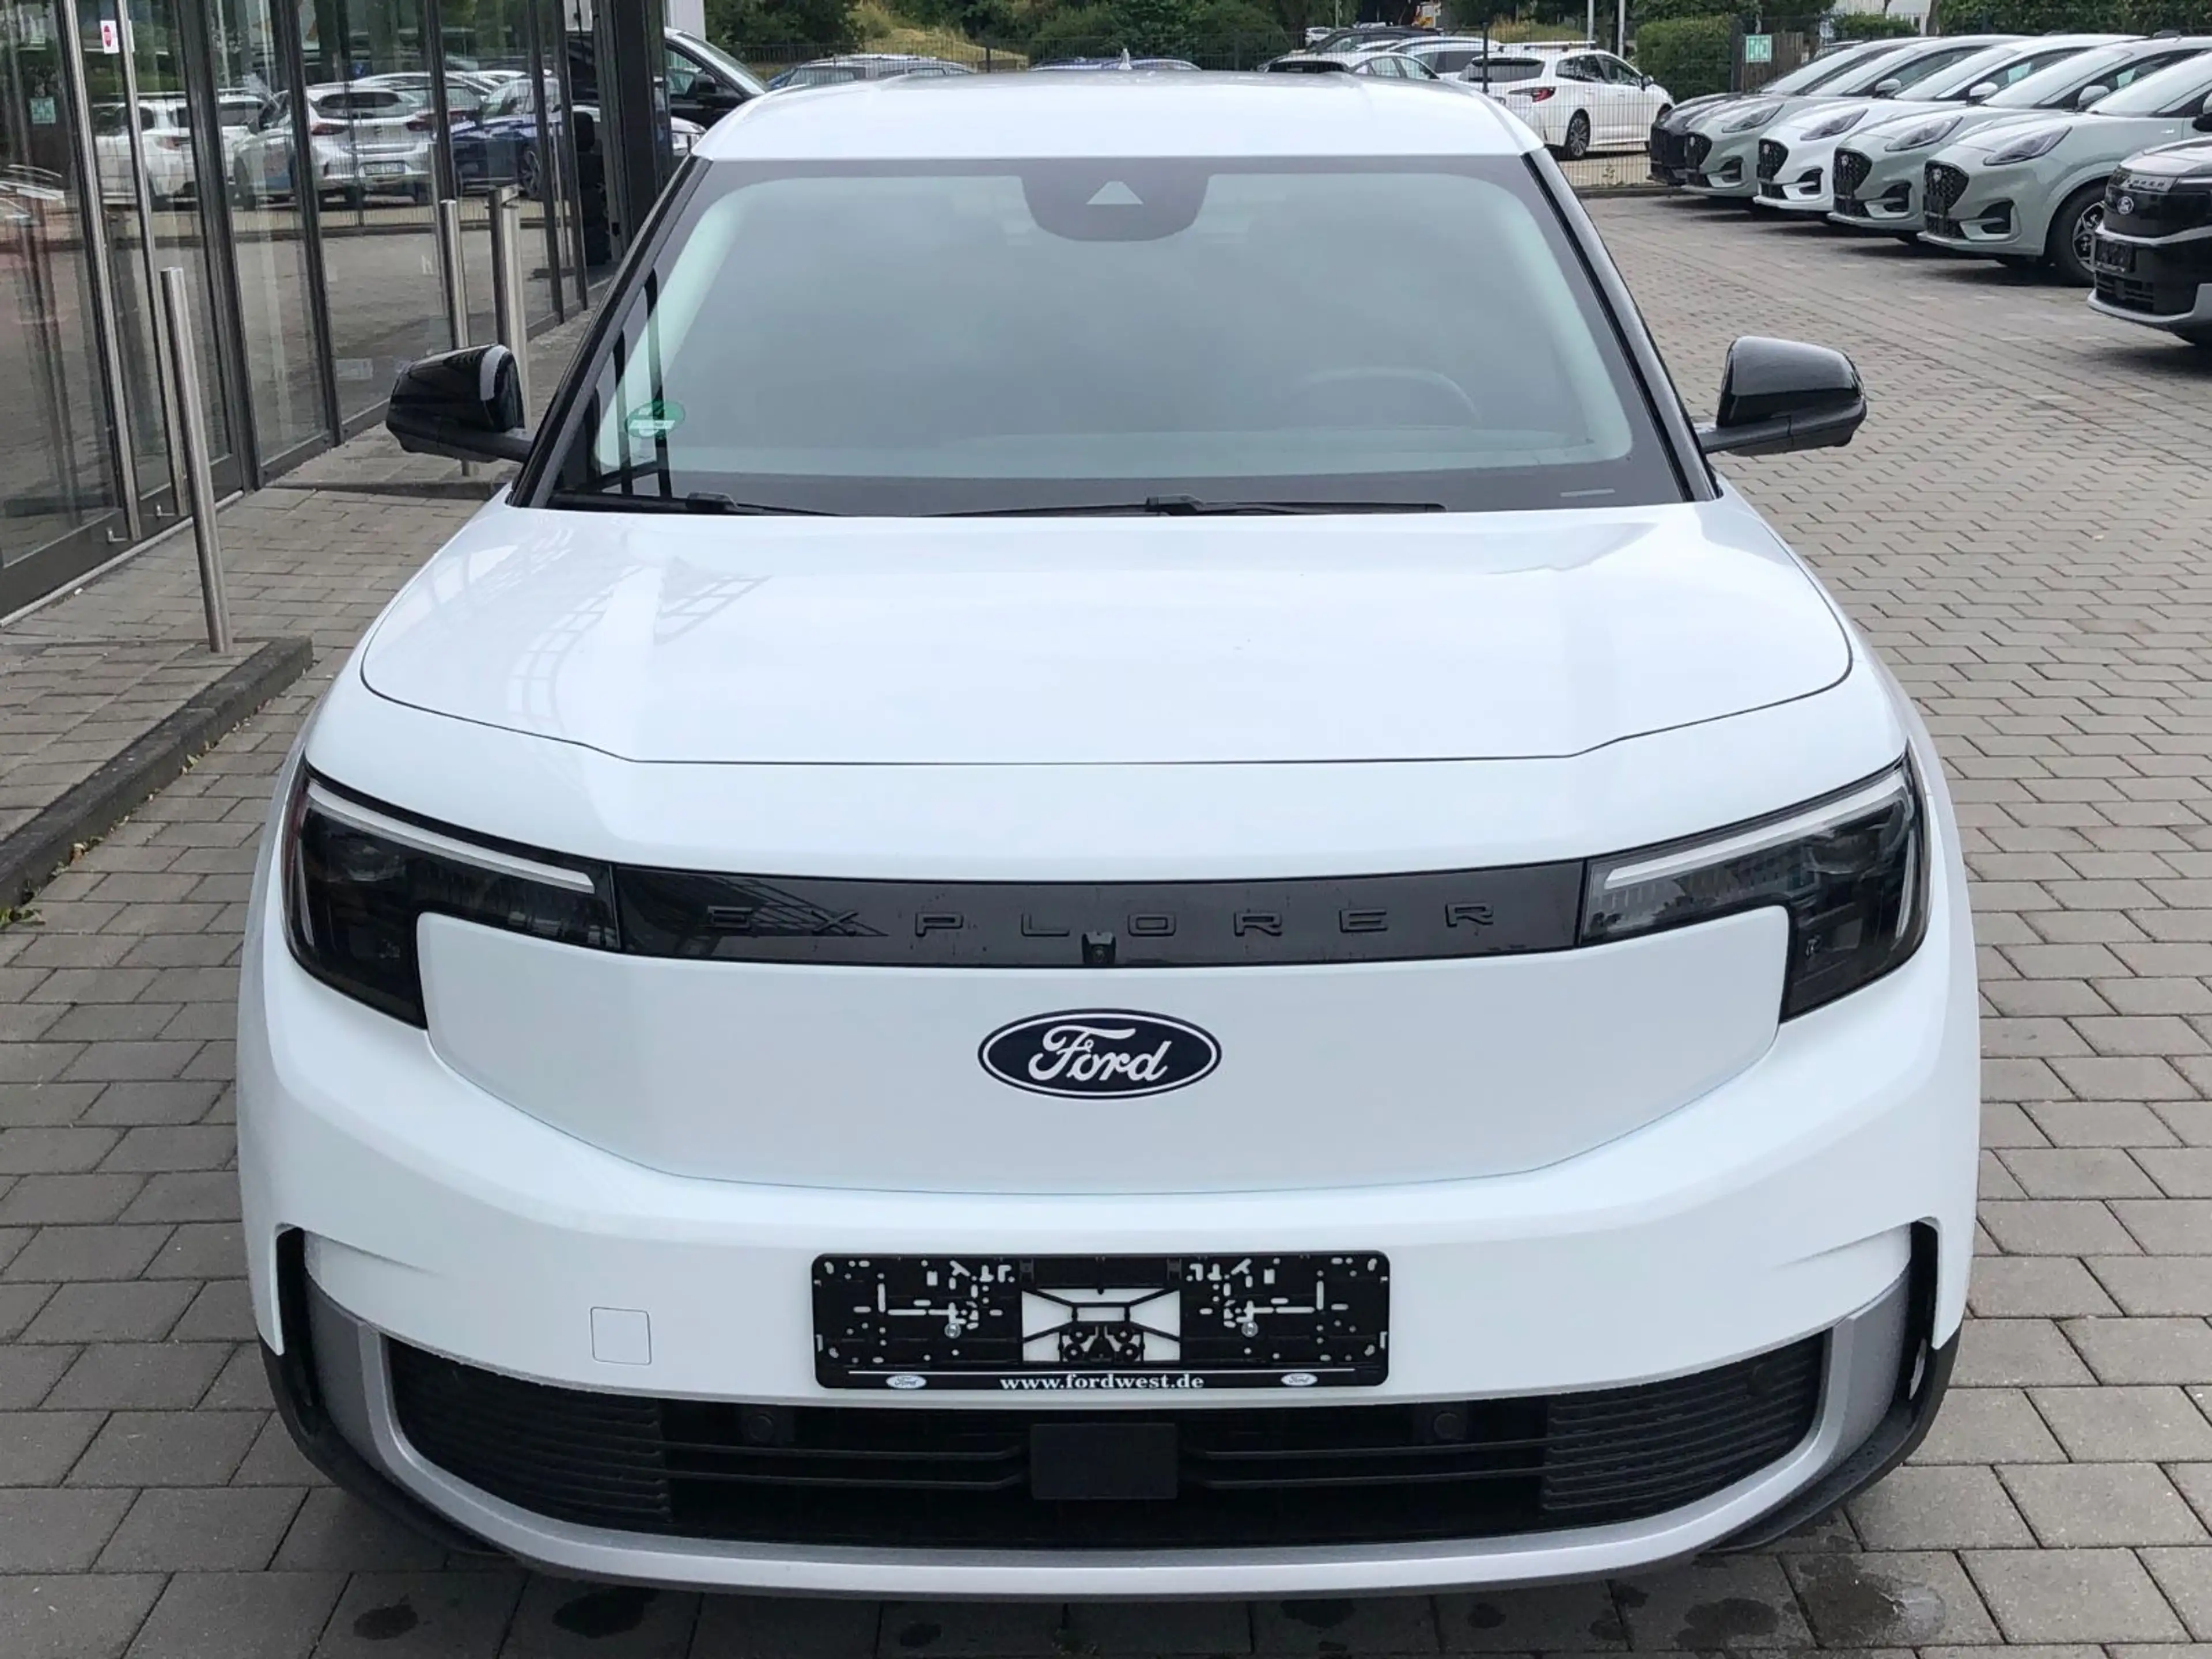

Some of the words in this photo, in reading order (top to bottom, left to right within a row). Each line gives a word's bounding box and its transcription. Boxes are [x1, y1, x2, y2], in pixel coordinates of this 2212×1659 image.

[707, 901, 1495, 937] EXPLORER
[1028, 1025, 1172, 1082] Ford
[999, 1373, 1205, 1389] www.fordwest.de
